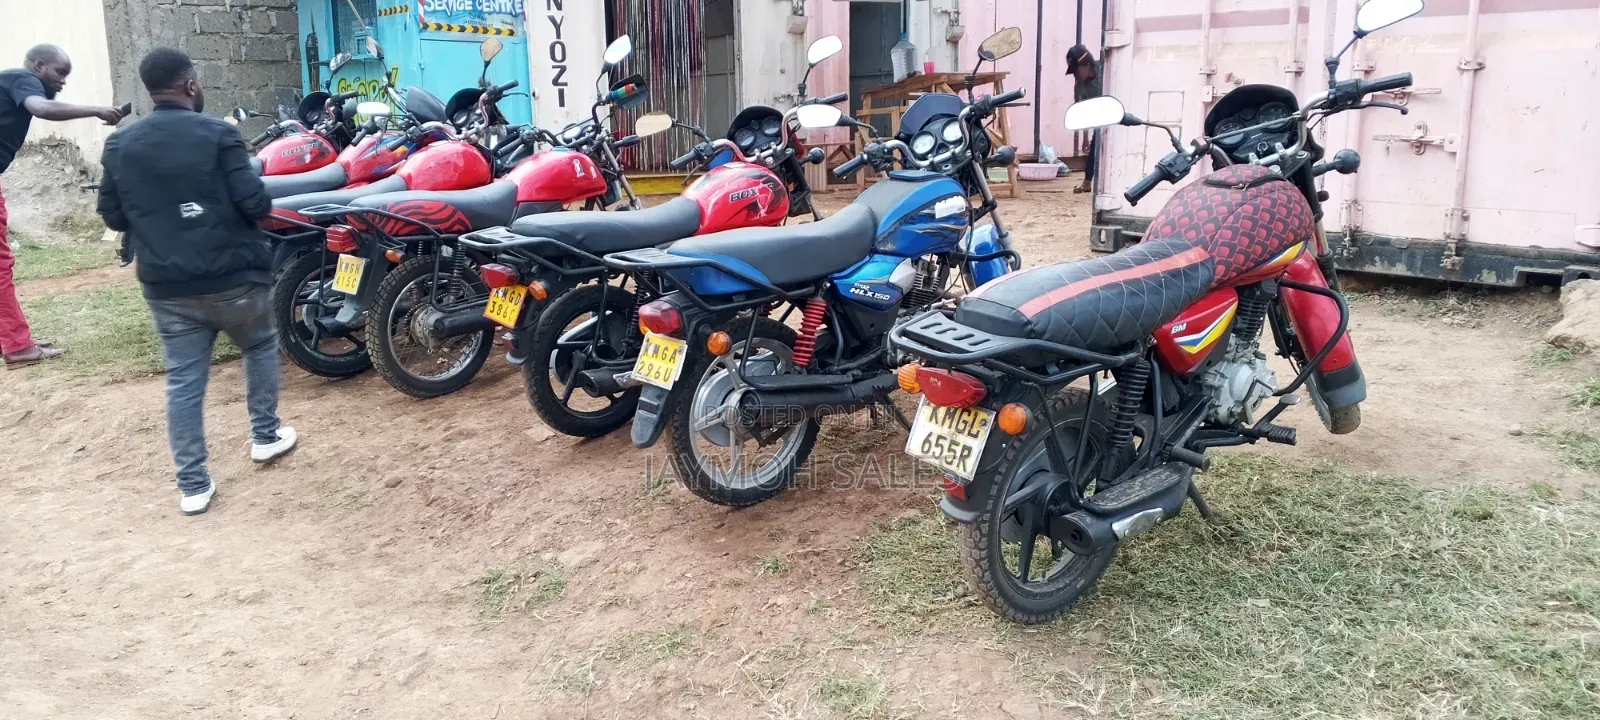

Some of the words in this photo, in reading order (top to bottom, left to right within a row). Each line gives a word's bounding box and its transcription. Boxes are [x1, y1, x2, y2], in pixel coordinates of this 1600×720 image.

[423, 0, 473, 16] SERVICE
[476, 0, 523, 16] CENTRE
[339, 260, 361, 275] KMGH
[494, 287, 522, 306] KMGD
[1171, 322, 1187, 334] BM
[643, 341, 678, 364] KMGA
[636, 360, 673, 383] 296U
[928, 406, 981, 439] KMGL
[921, 431, 973, 473] 655R
